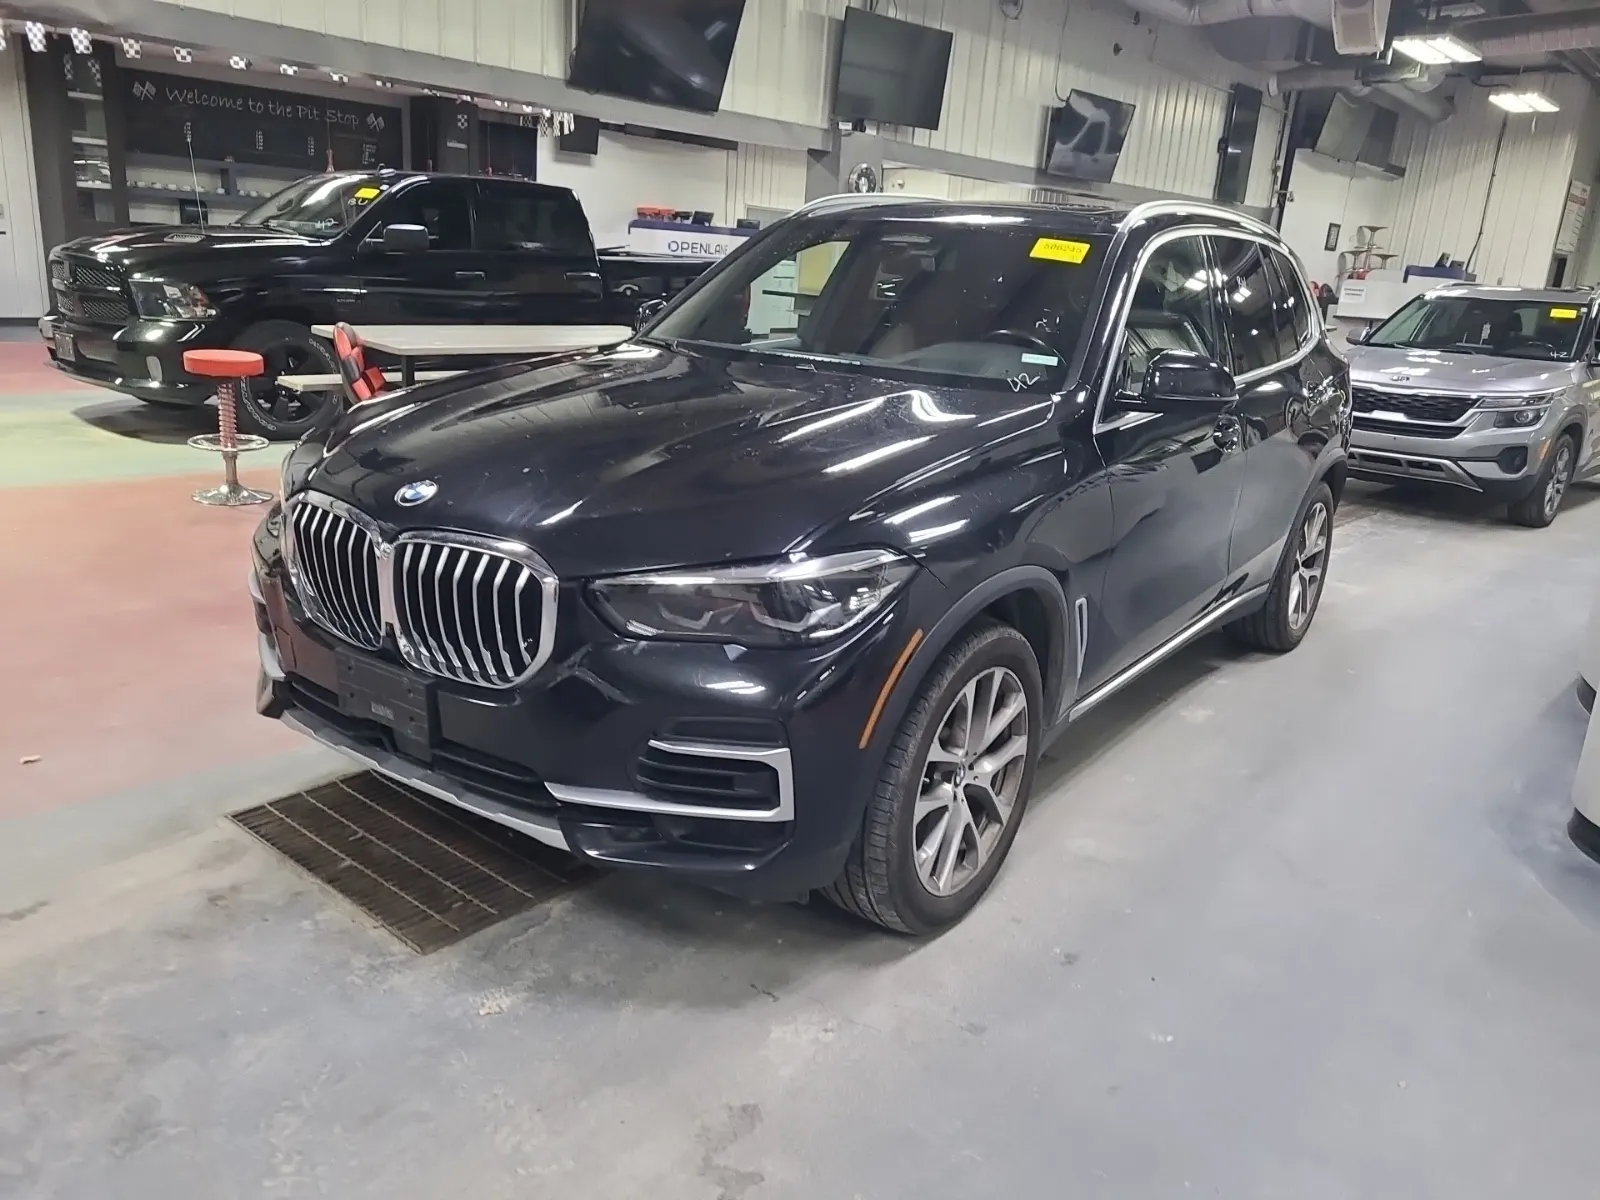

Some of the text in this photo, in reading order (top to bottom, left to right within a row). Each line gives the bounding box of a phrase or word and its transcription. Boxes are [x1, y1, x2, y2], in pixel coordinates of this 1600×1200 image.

[165, 87, 360, 130] Welcome to the Pit Stop
[668, 240, 729, 255] OPENLANE
[1006, 372, 1041, 392] 42
